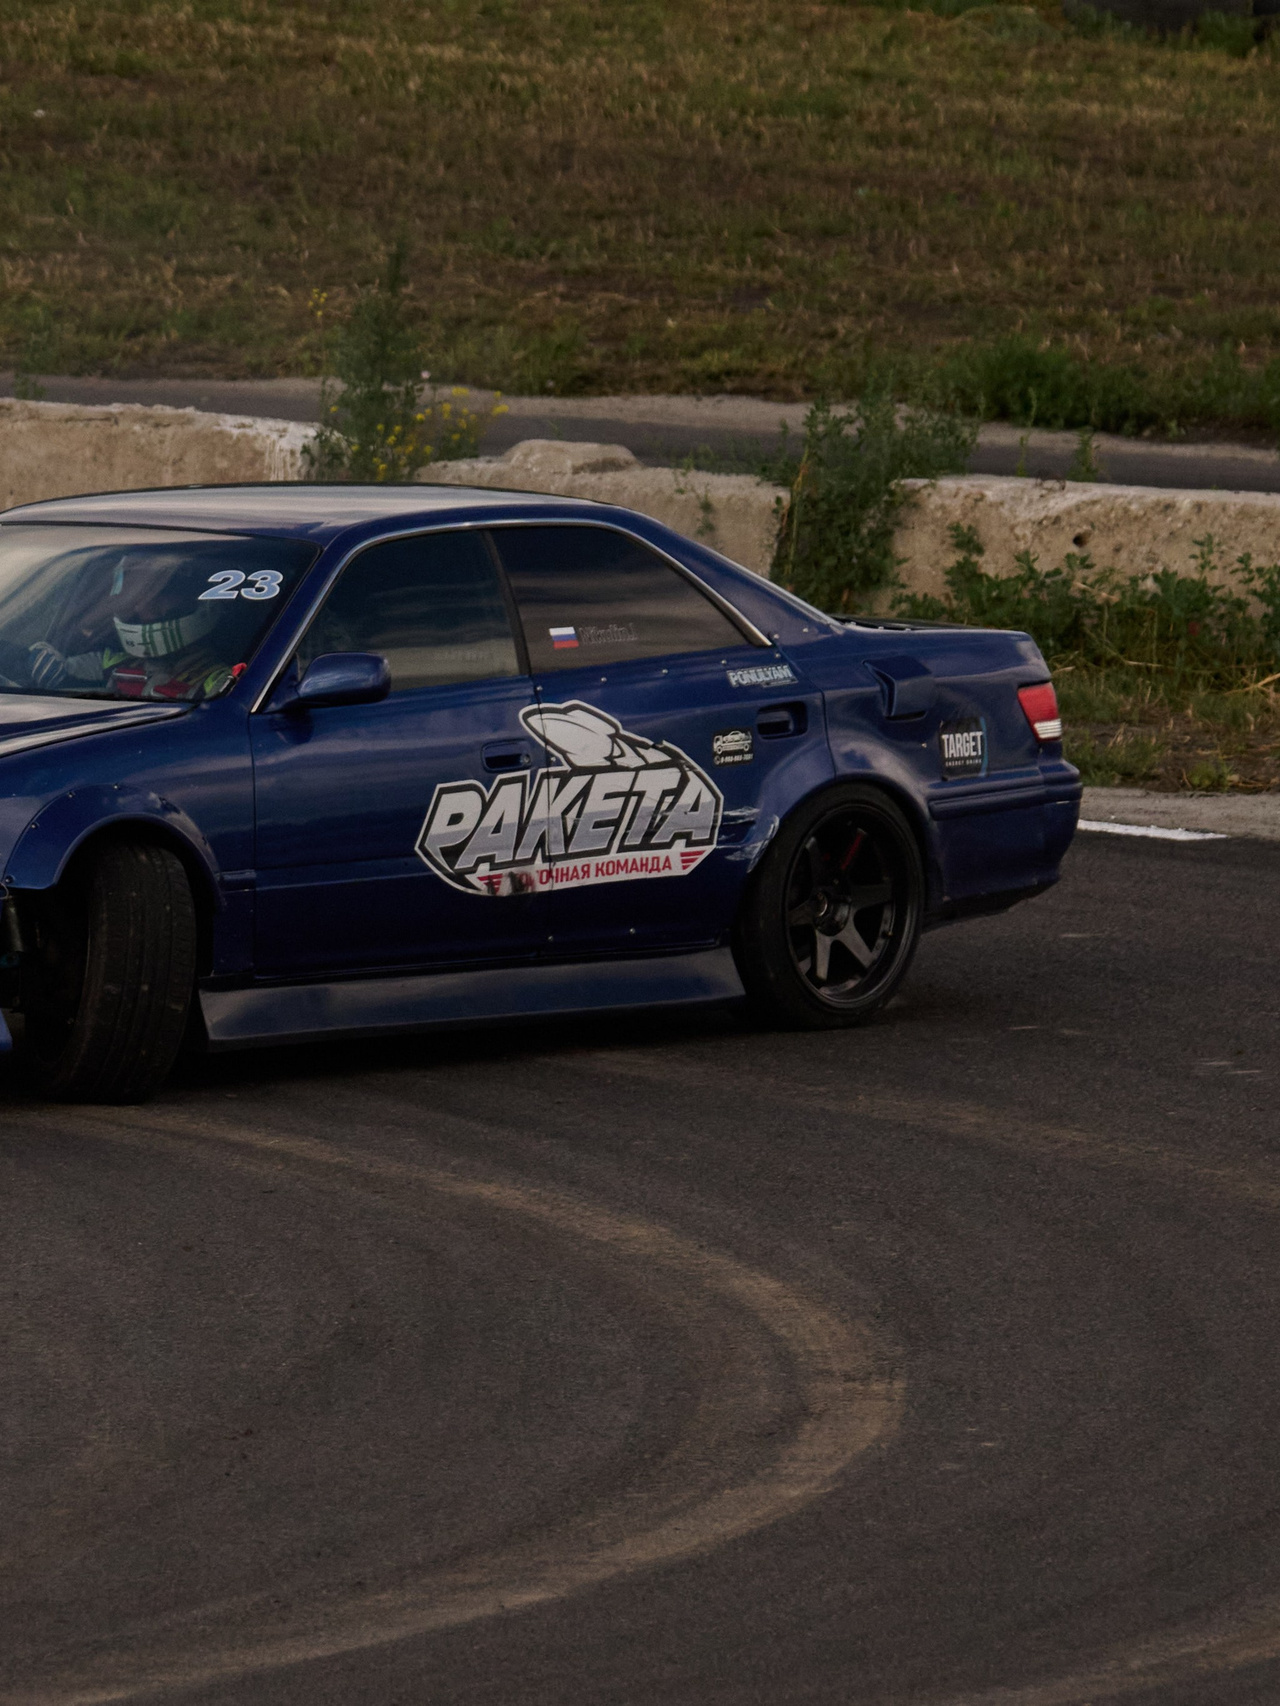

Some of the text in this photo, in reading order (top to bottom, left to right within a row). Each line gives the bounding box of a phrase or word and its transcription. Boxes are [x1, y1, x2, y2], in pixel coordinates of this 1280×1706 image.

[198, 569, 284, 600] 23
[941, 731, 984, 759] TARGET
[595, 855, 672, 877] КОМАНДА
